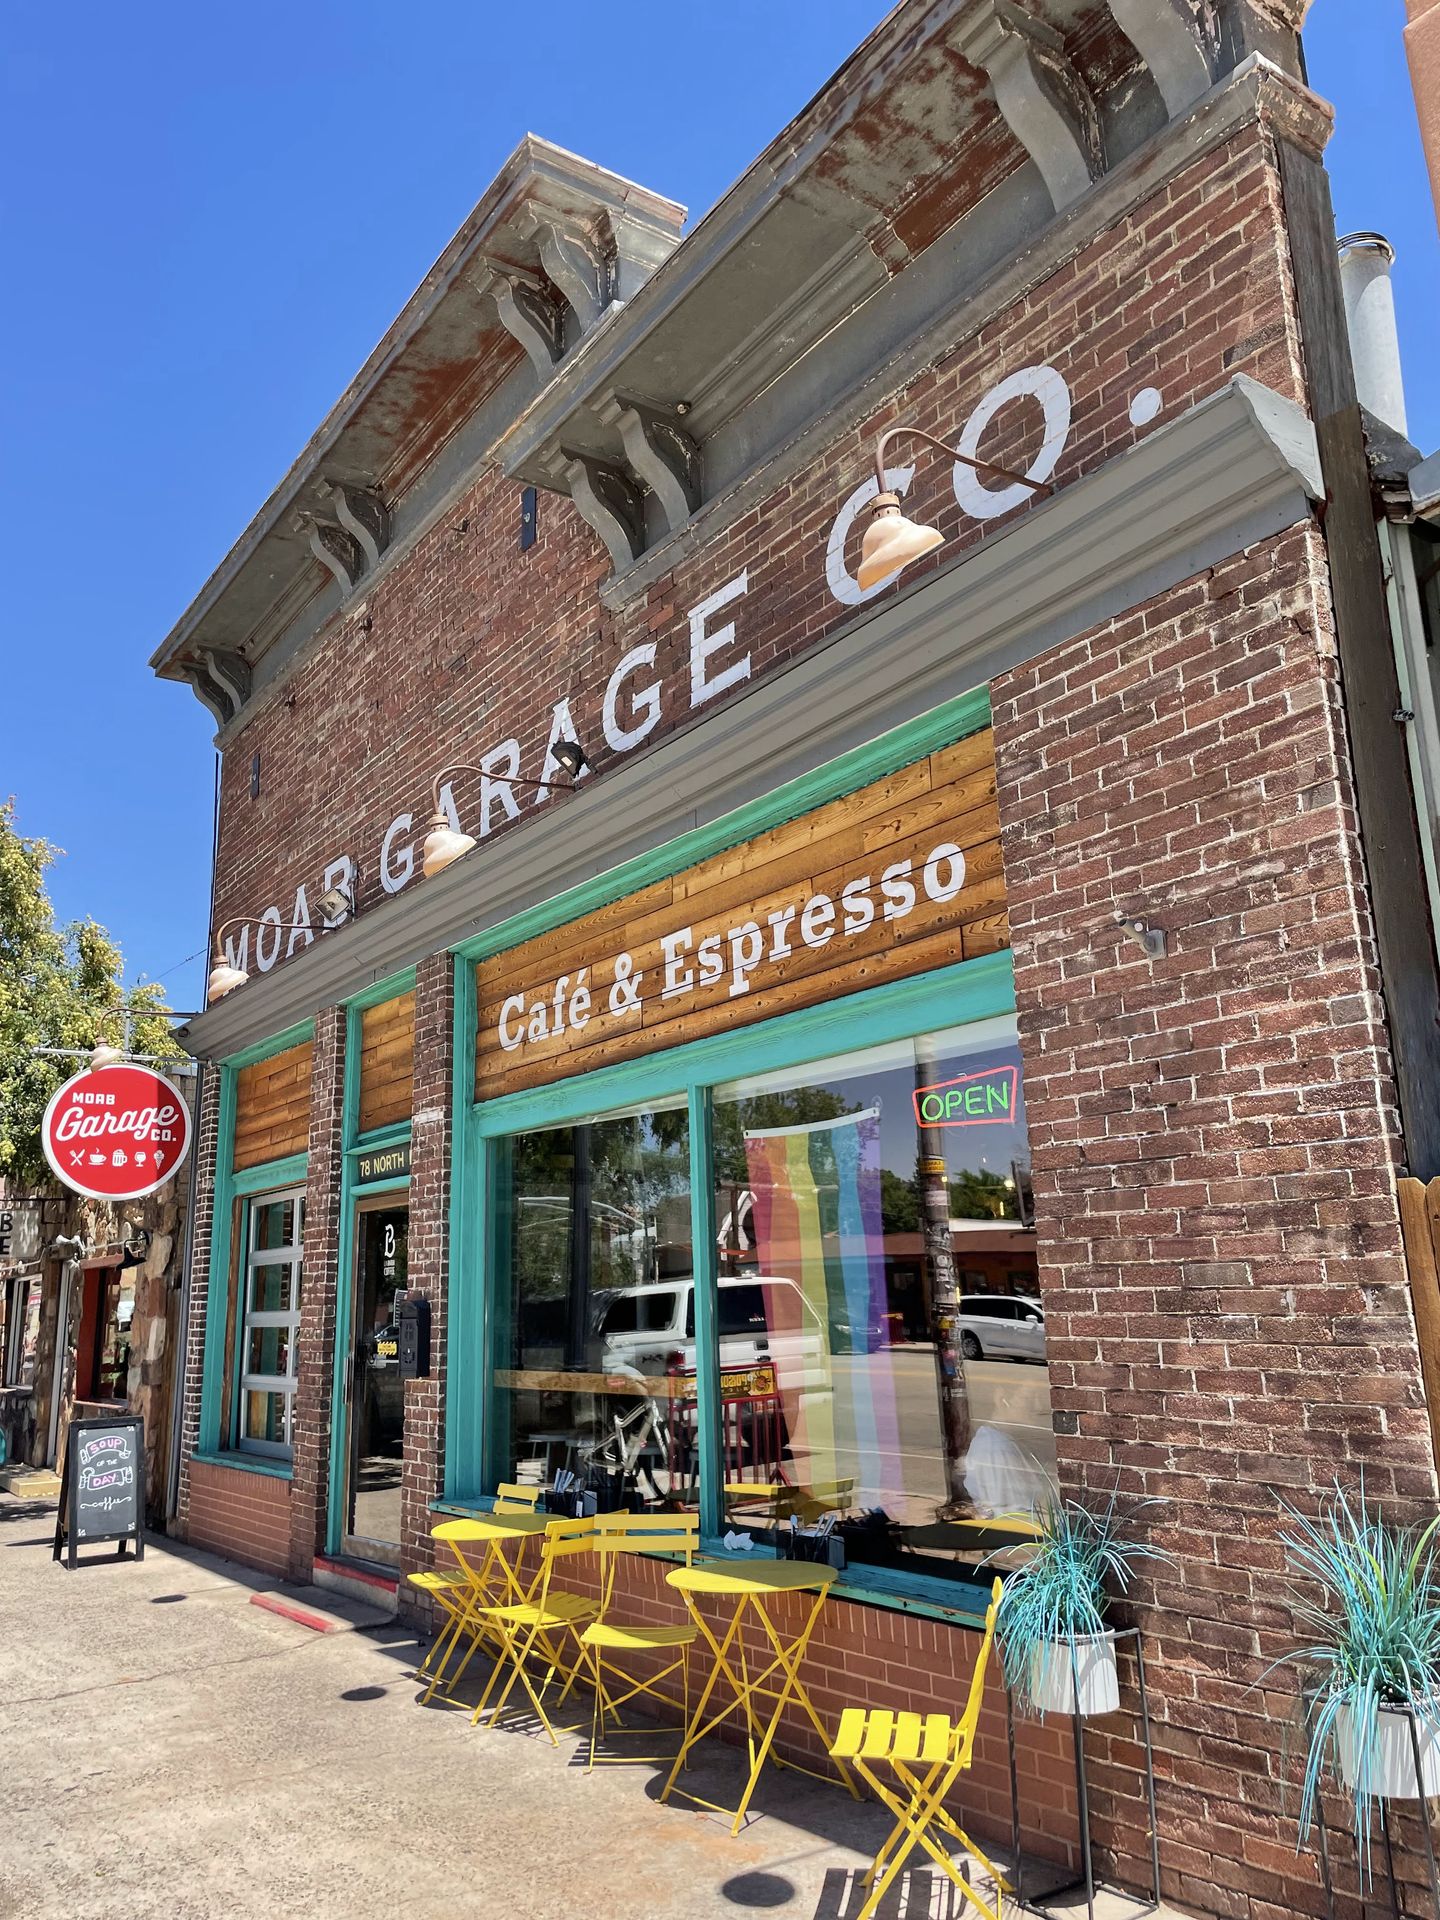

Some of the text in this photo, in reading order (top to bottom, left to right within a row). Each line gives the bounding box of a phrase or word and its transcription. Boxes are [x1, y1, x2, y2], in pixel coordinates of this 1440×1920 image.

[223, 855, 351, 996] MOAB
[826, 365, 1163, 605] CO.
[498, 843, 966, 1051] Café & Espresso
[72, 1092, 115, 1105] MOAB
[921, 1081, 1009, 1121] OPEN
[55, 1105, 179, 1141] Garage
[150, 1128, 177, 1141] CO.
[360, 1160, 371, 1177] 78
[373, 1151, 405, 1175] NORTH
[90, 1438, 122, 1454] SOUP
